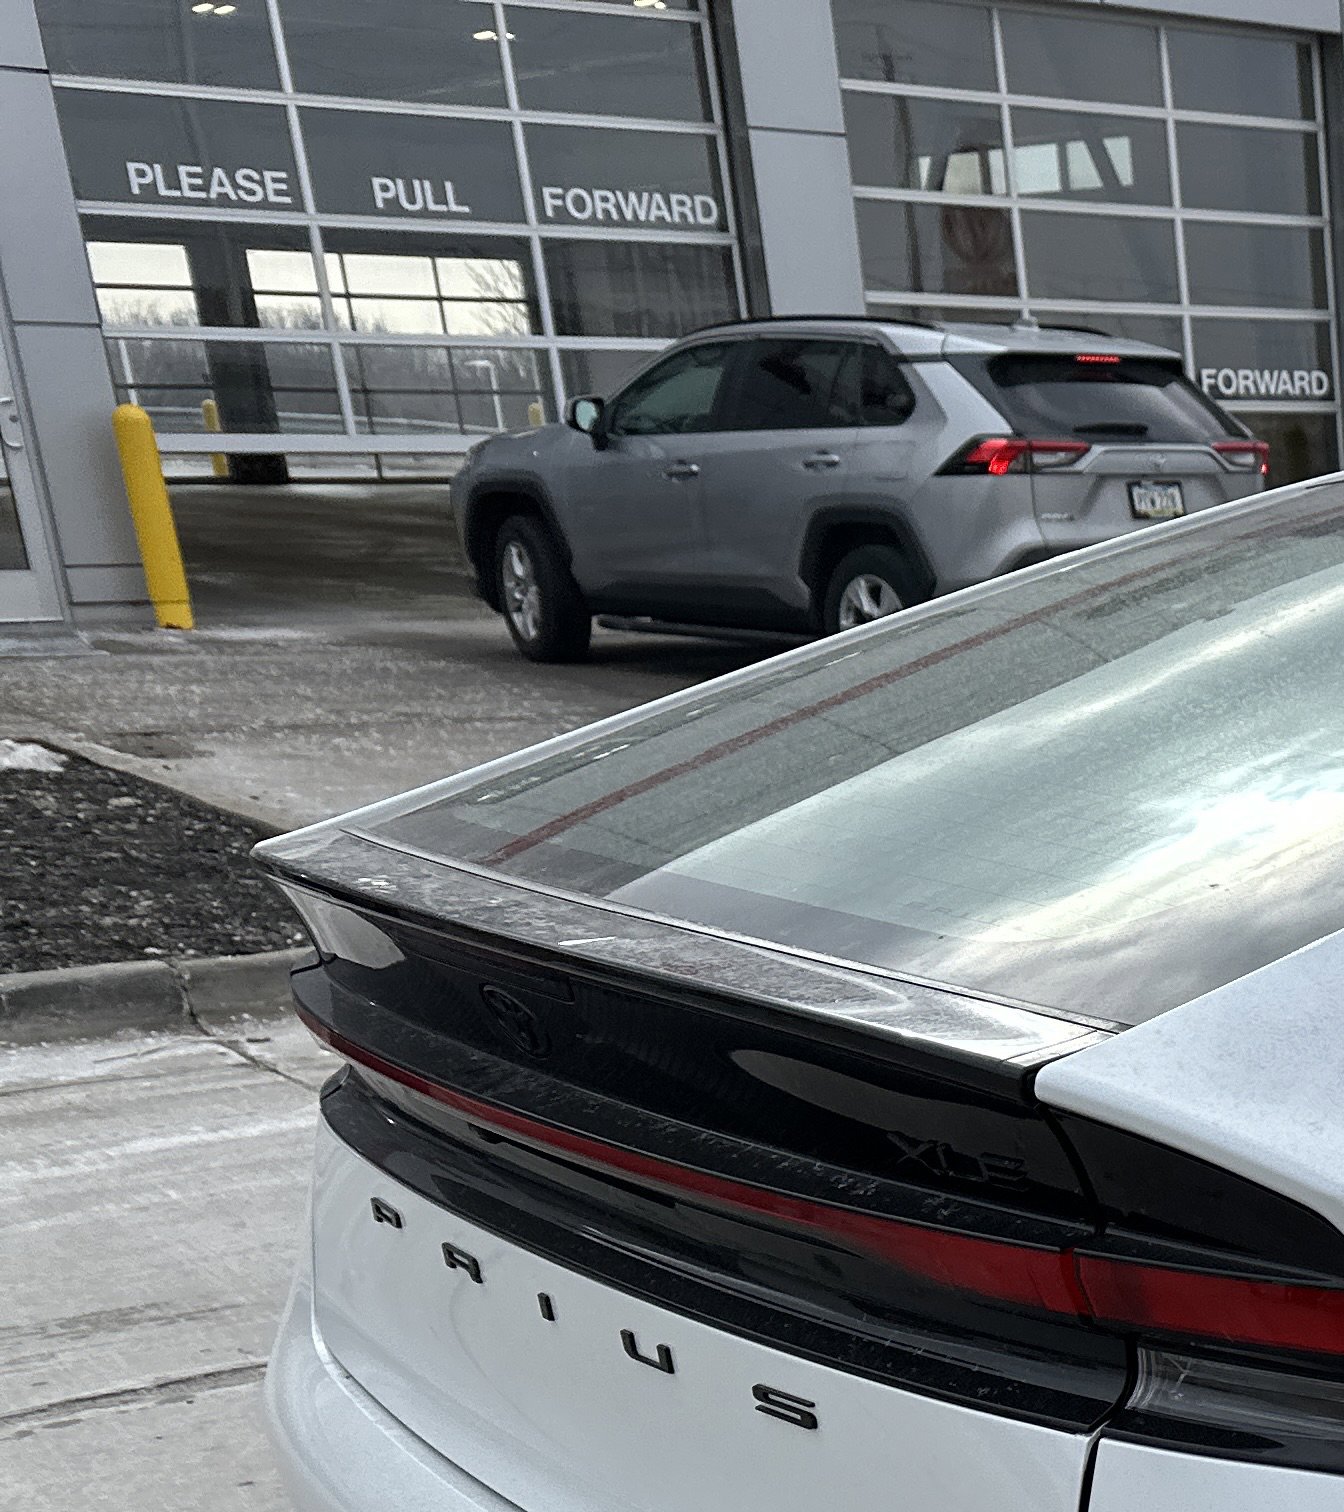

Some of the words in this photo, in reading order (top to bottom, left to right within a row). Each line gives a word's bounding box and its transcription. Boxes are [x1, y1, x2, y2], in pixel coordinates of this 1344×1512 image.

[126, 161, 292, 204] PLEASE
[370, 176, 470, 214] PULL
[542, 186, 718, 226] FORWARD
[1200, 367, 1329, 396] FORWARD
[886, 1131, 1029, 1192] XLE
[370, 1196, 818, 1430] PRIUS
